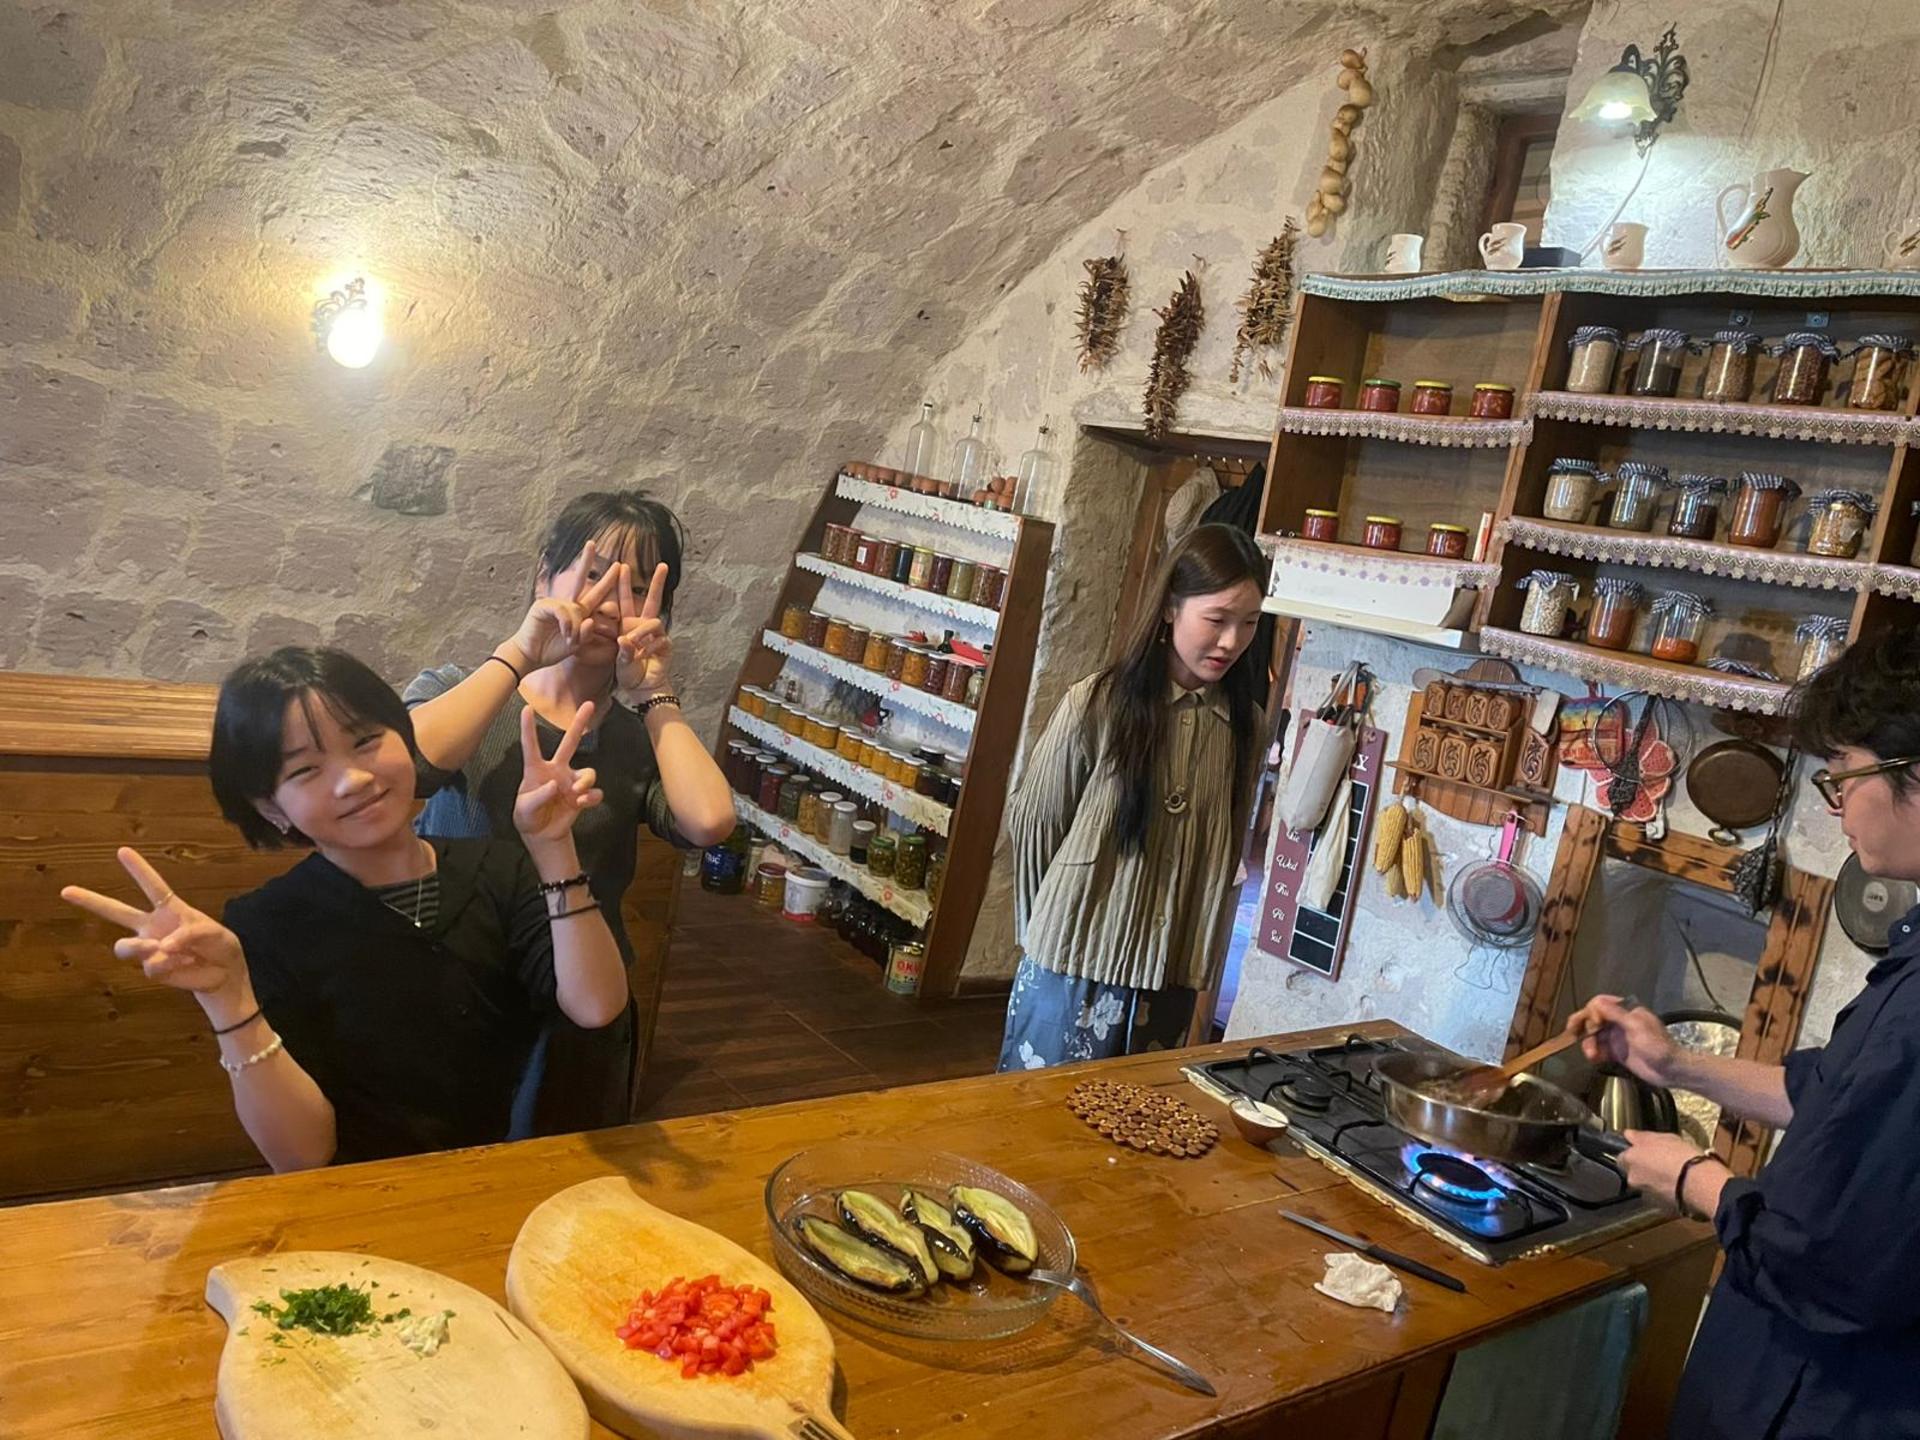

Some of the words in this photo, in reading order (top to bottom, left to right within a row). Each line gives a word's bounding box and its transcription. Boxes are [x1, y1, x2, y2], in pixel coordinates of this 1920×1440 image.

[1276, 854, 1298, 872] Wed
[1275, 882, 1289, 897] Thu
[1272, 907, 1285, 921] Fri
[1270, 929, 1282, 943] Sat
